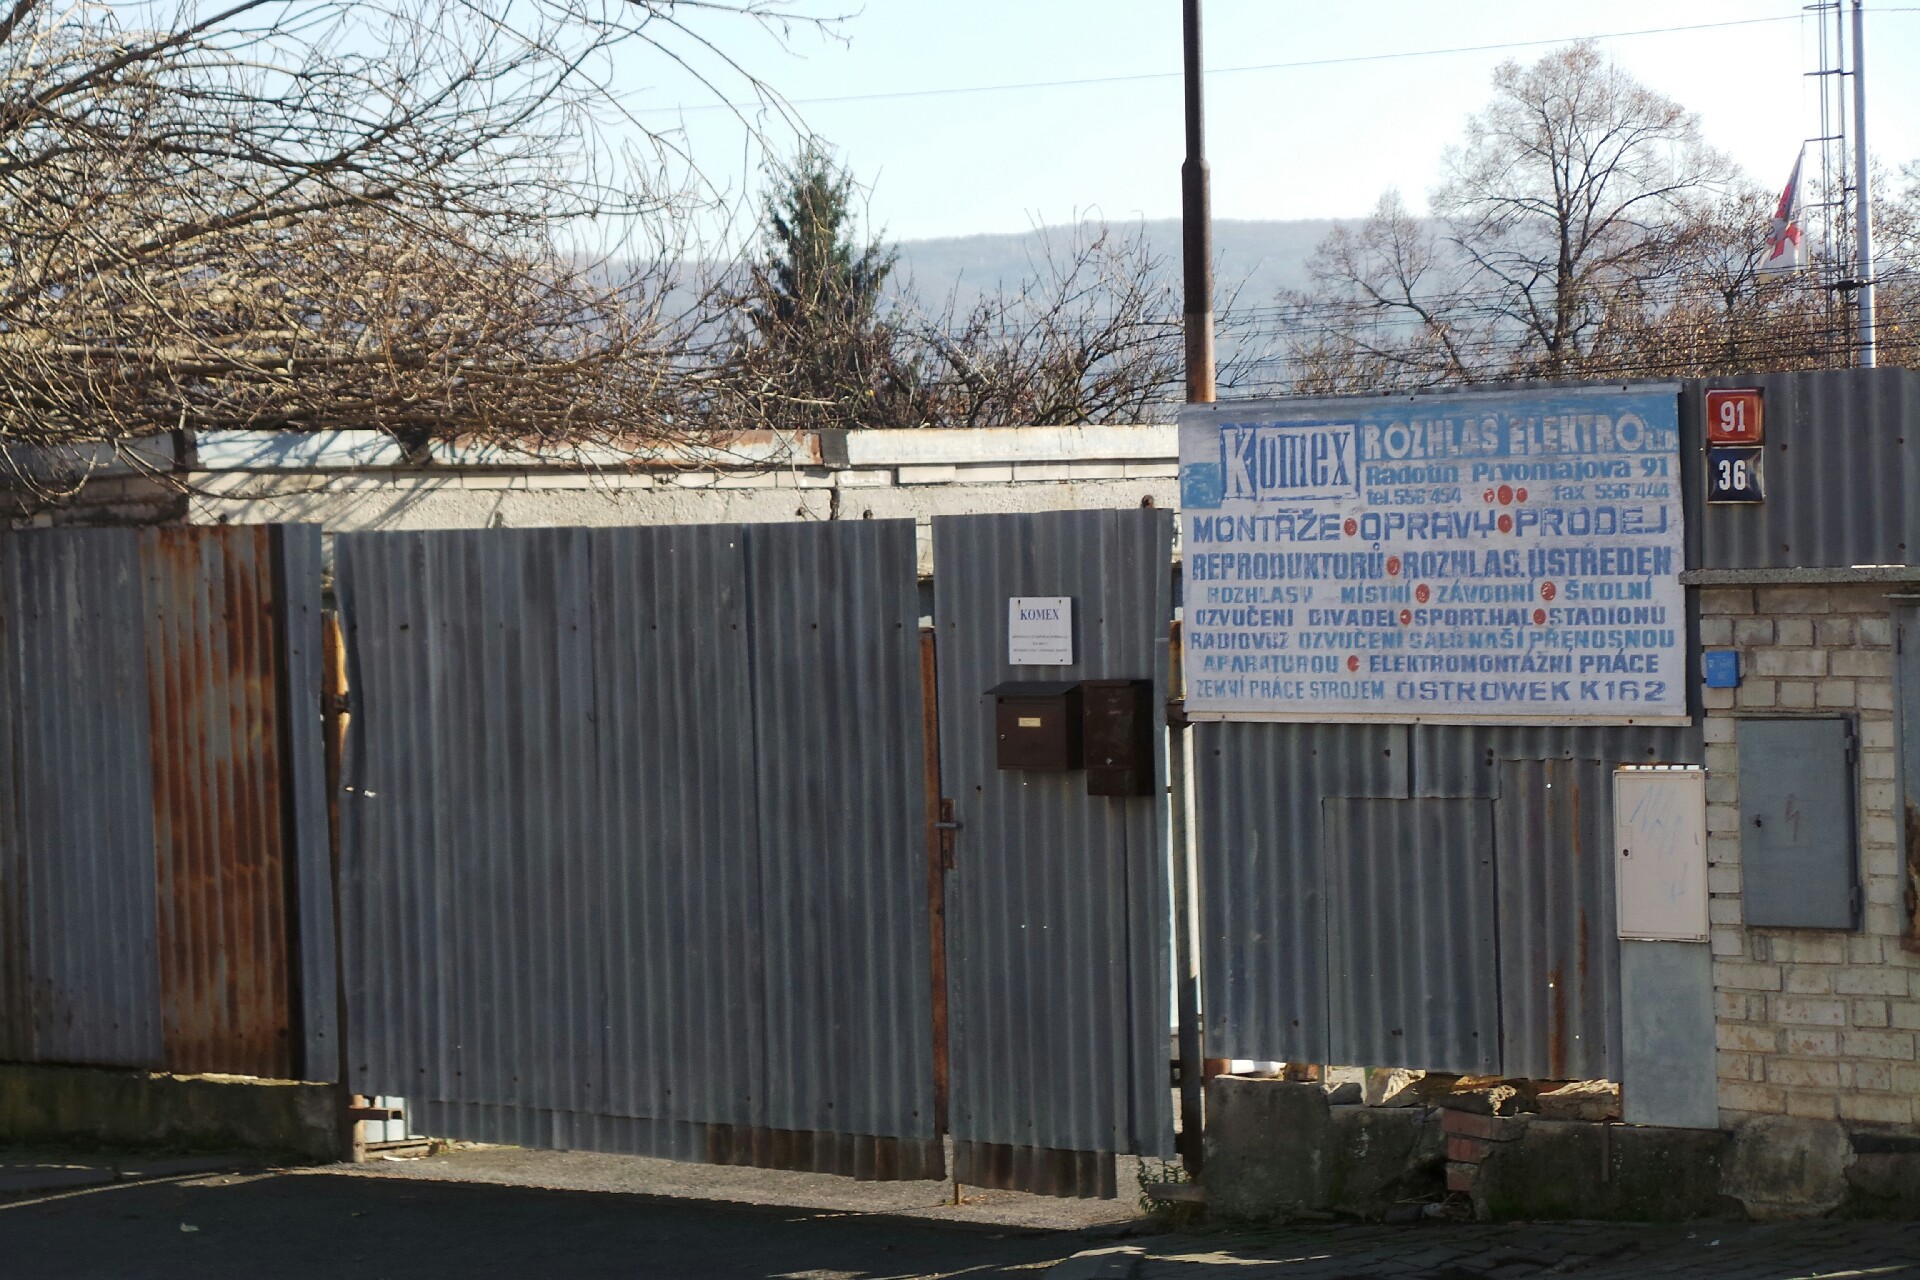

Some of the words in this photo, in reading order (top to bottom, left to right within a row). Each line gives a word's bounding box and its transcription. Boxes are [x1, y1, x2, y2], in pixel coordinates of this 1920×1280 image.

[1721, 401, 1745, 432] 91
[1364, 417, 1499, 460] ROZHLAS
[1509, 413, 1644, 455] ELEKTRO
[1641, 456, 1668, 477] 91
[1718, 460, 1746, 490] 36
[1553, 484, 1585, 501] fax
[1594, 482, 1631, 500] 556
[1634, 482, 1670, 498] 444
[1361, 509, 1496, 540] OPRAVY
[1515, 505, 1667, 537] PRODEJ
[1192, 543, 1384, 580] REPRODUKTORŮ
[1341, 582, 1411, 604] MÍSTNÍ
[1438, 578, 1535, 604] ZÁVODNÍ
[1564, 575, 1652, 601] ŠKOLNÍ
[1020, 608, 1060, 621] KOMEX
[1309, 608, 1398, 627] DIVADEL
[1370, 649, 1573, 673] ELEKTROMONTÁŽNÍ
[1580, 647, 1659, 673] PRÁCE
[1250, 677, 1304, 699] PRÁCE
[1309, 680, 1385, 699] STROJEM
[1397, 680, 1571, 701] OSTROWEK
[1580, 680, 1666, 702] K162
